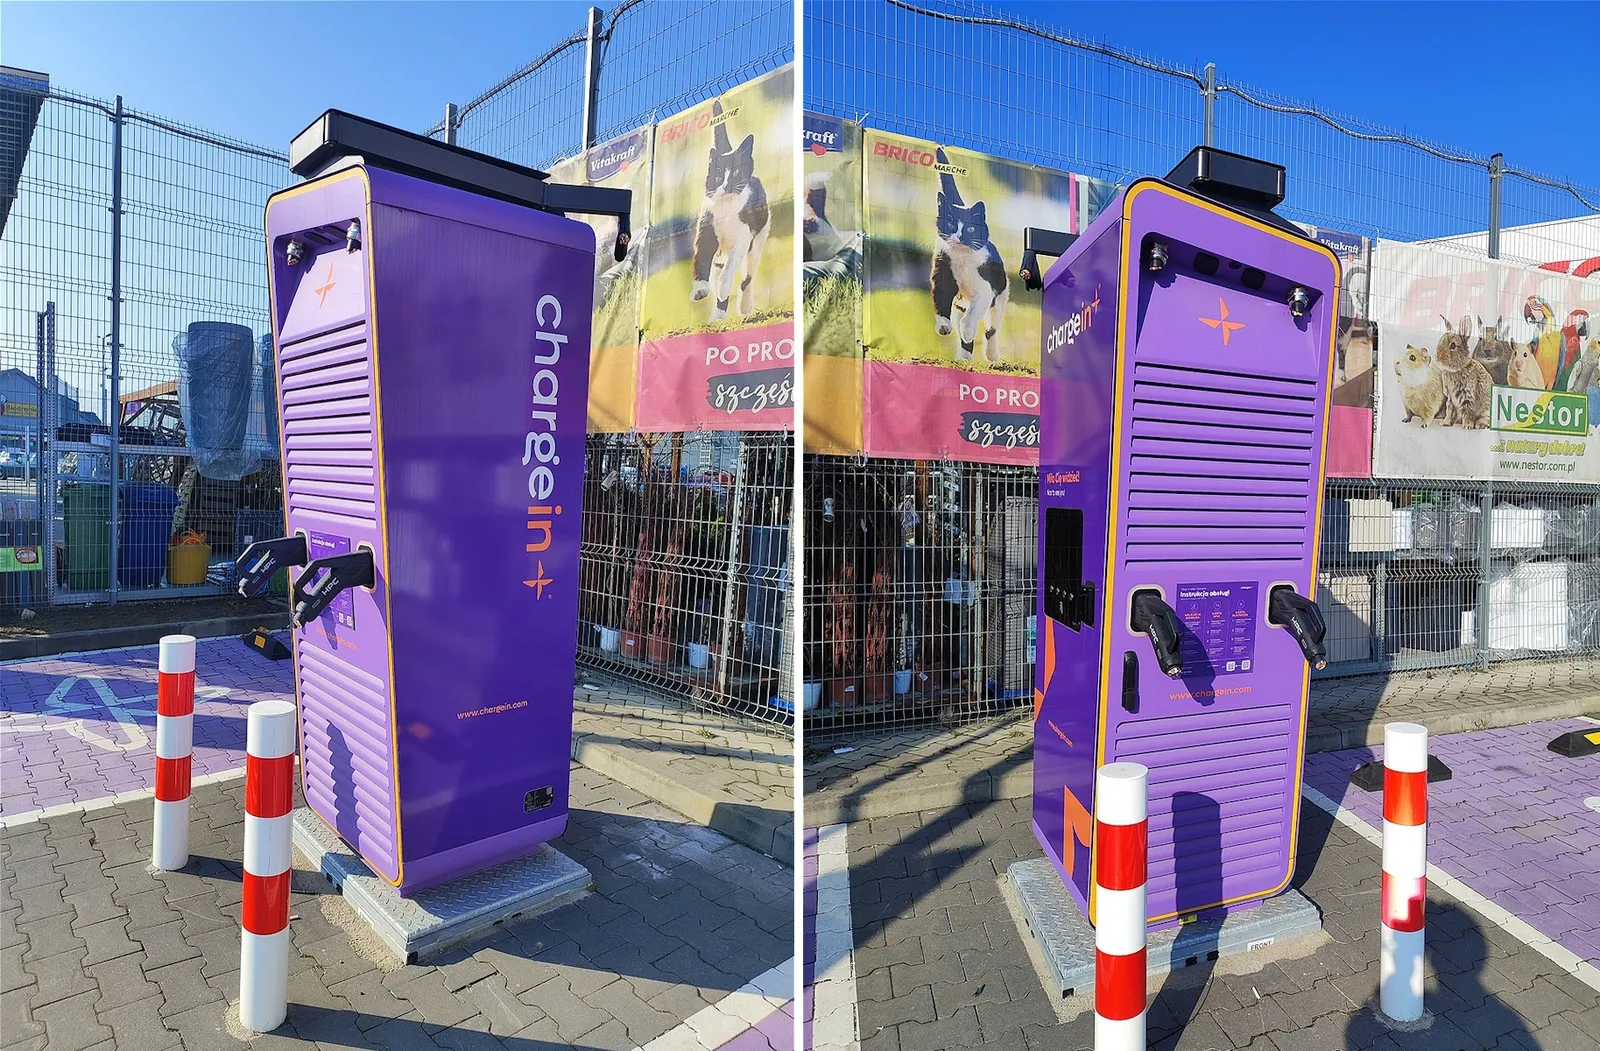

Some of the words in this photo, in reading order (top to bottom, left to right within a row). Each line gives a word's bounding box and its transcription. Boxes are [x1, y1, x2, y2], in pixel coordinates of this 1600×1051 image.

[661, 112, 712, 145] BRICO
[590, 144, 637, 173] Vitakraft
[873, 141, 935, 167] BRICO
[1046, 301, 1093, 354] chargein
[705, 345, 740, 366] PO
[747, 338, 795, 364] PRO
[715, 372, 795, 415] szczęś
[959, 383, 989, 404] PO
[996, 388, 1040, 409] PRO
[521, 294, 569, 552] chargein
[1496, 393, 1584, 428] Nestor
[968, 418, 1041, 451] szczęś
[1499, 460, 1577, 474] www.nestor.com.pl
[260, 557, 277, 574] HPC
[321, 577, 340, 597] HPC
[1169, 684, 1253, 701] www.chargein.com
[456, 700, 529, 720] www.chargein.com
